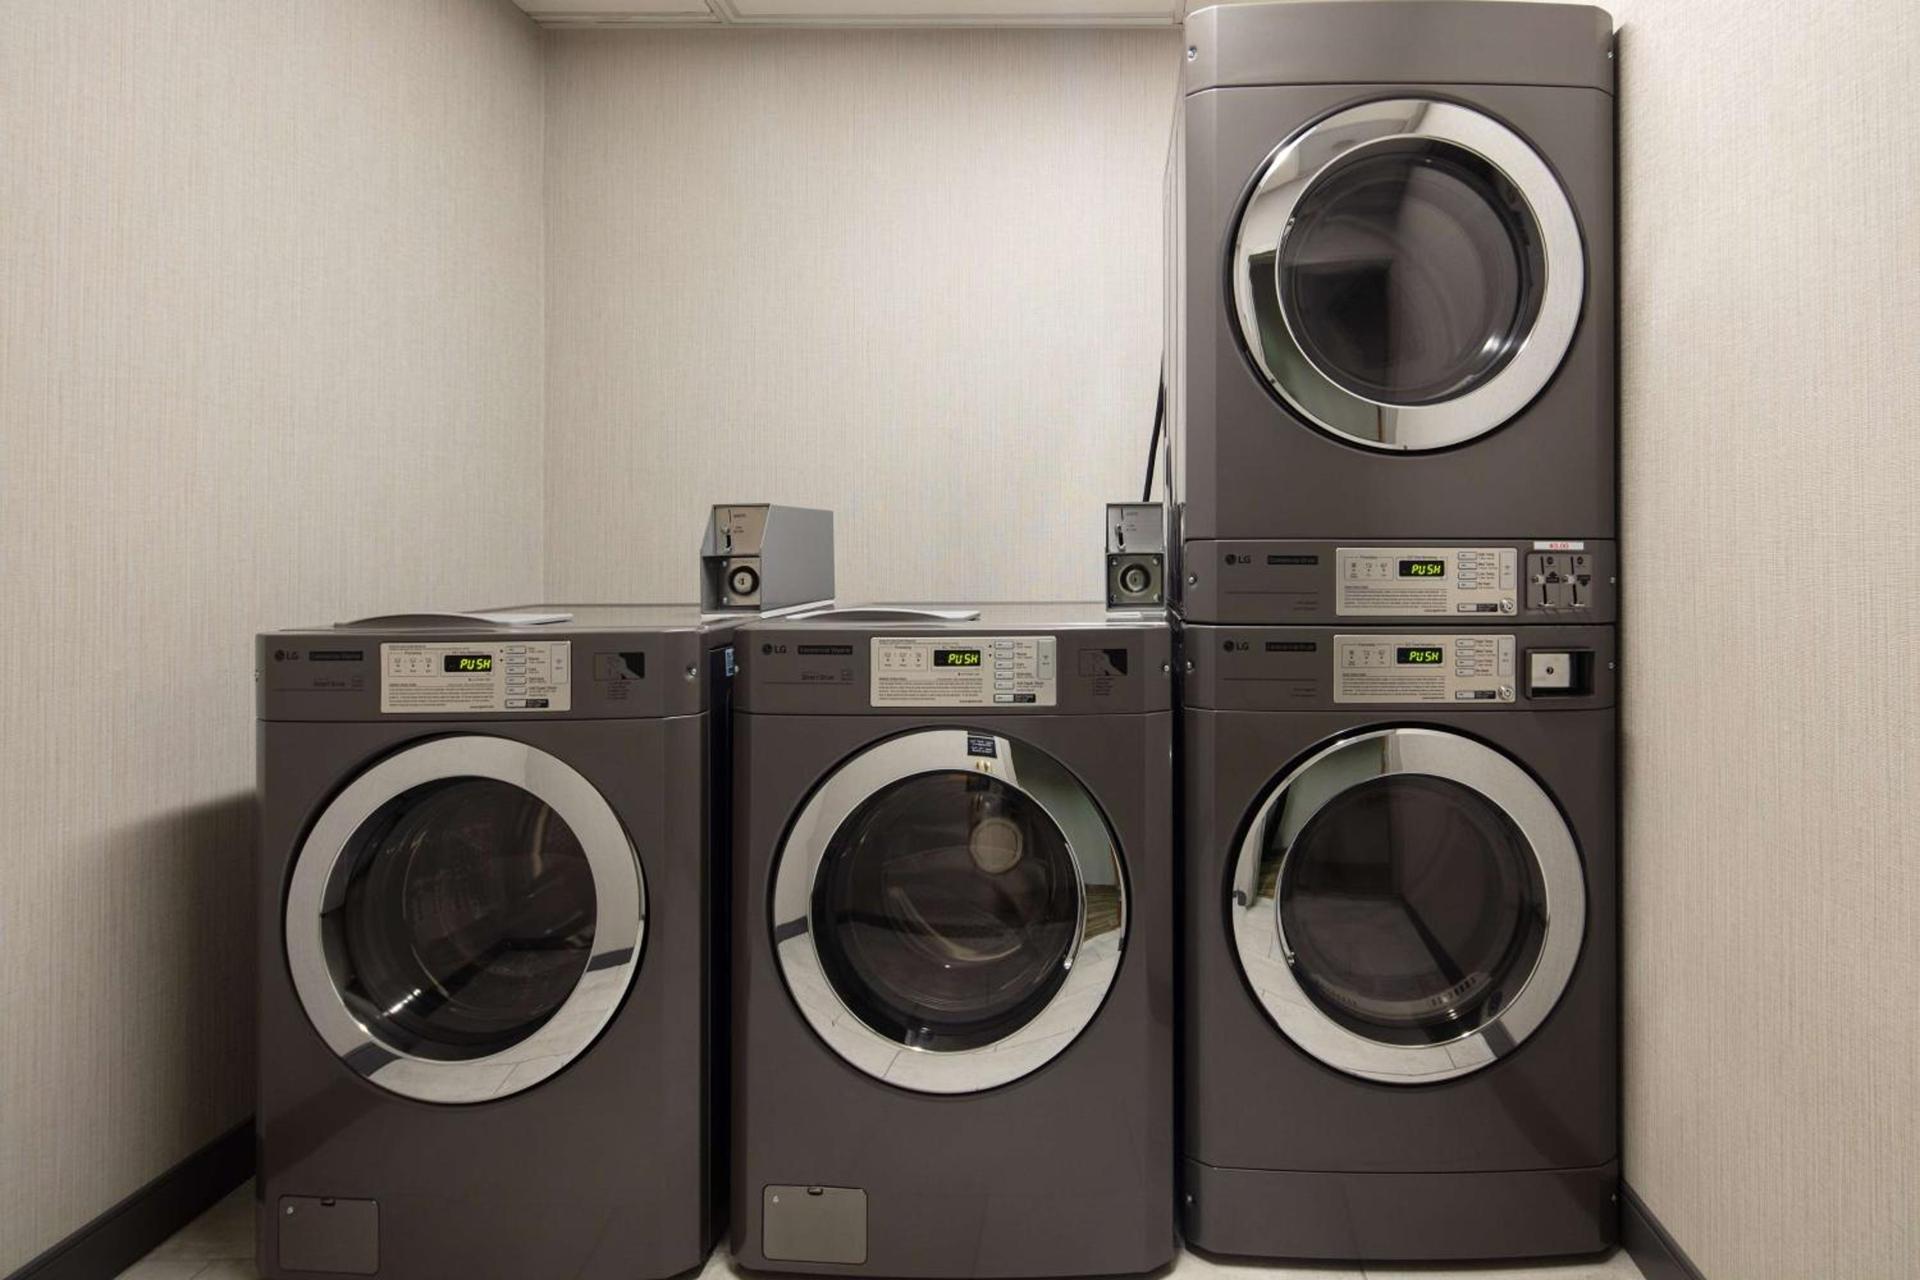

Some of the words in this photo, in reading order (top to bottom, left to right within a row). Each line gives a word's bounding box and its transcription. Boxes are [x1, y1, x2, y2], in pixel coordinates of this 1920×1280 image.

[1411, 564, 1441, 575] PUSH
[947, 653, 979, 664] PUSH
[1409, 651, 1439, 662] PUSH
[459, 658, 491, 670] PUSH
